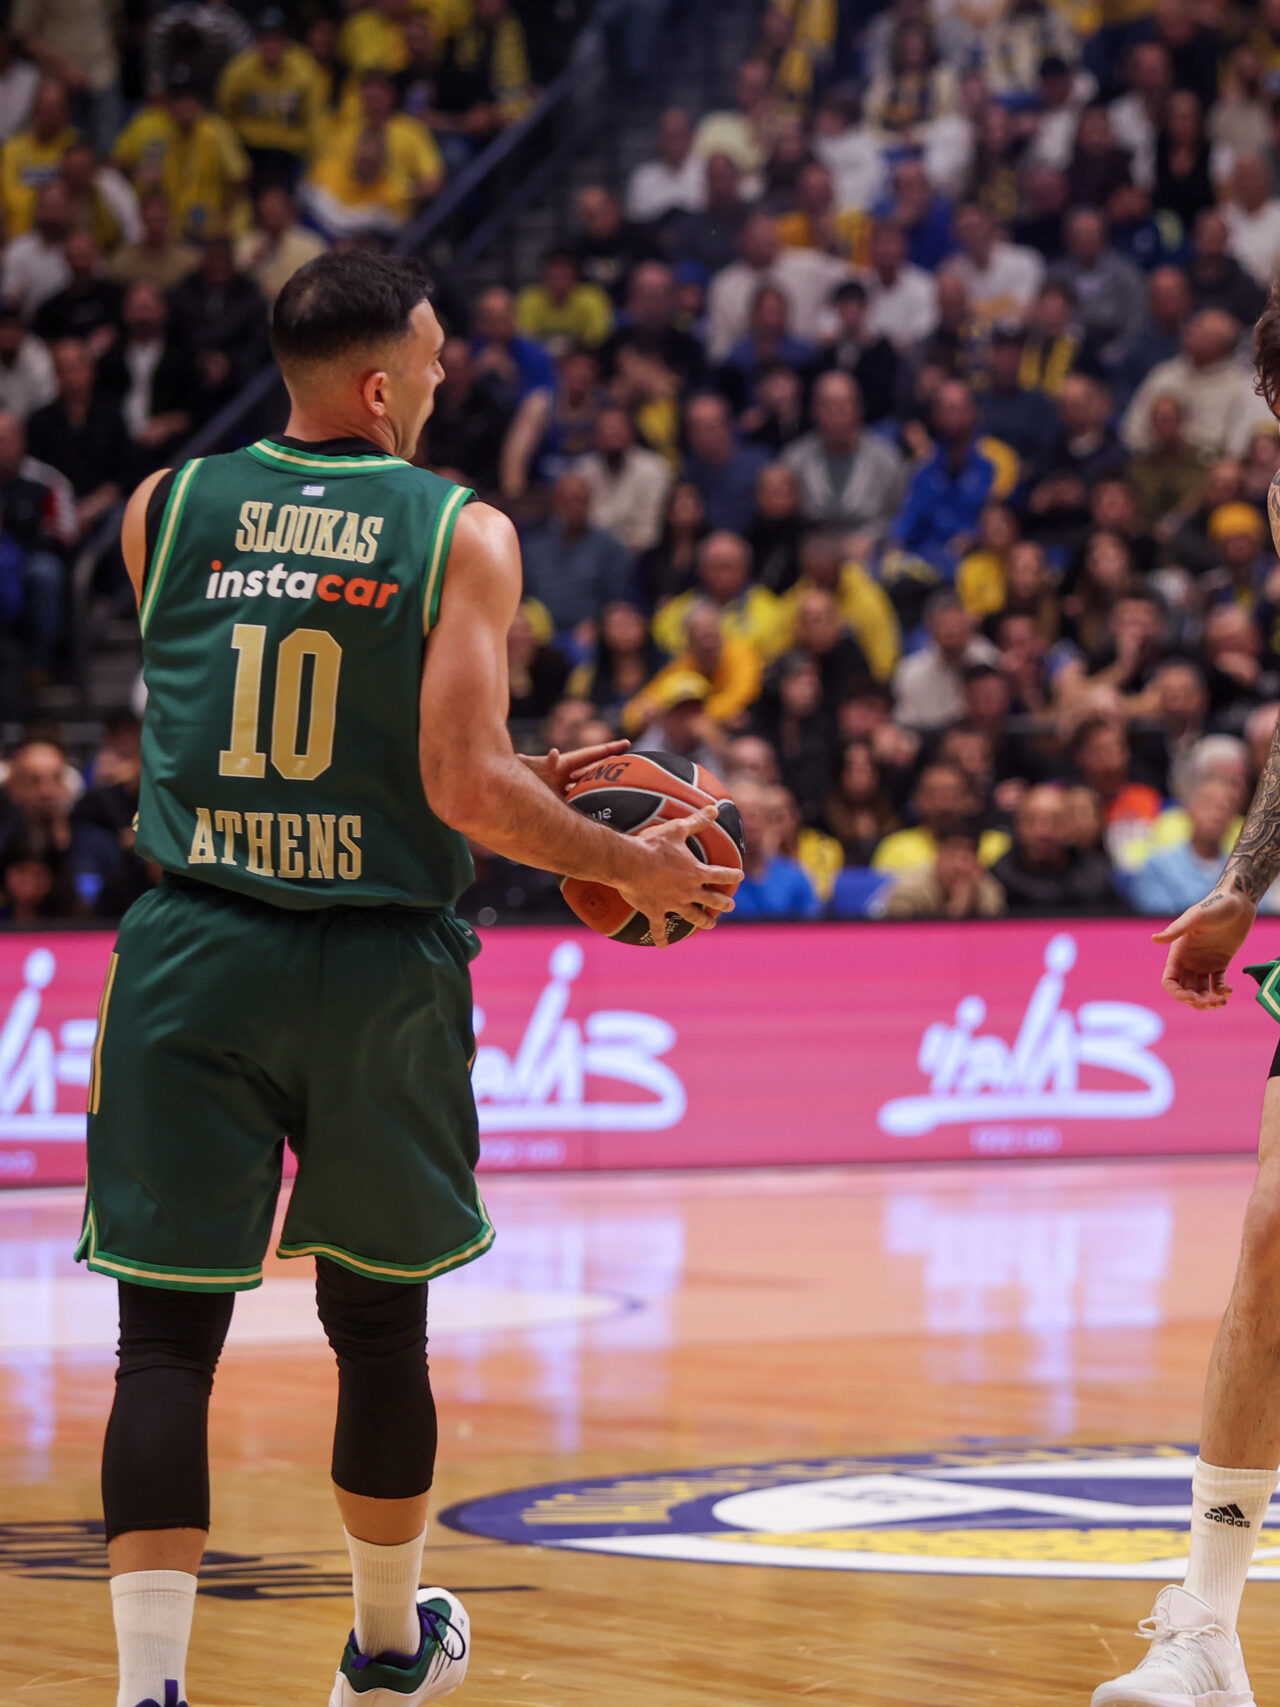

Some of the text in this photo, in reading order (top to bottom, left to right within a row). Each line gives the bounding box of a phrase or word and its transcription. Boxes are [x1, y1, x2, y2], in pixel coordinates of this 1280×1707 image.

[235, 500, 384, 564] SLOUKAS
[206, 559, 399, 609] instacar
[218, 622, 343, 781] 10
[188, 807, 363, 880] ATHENS
[1204, 1511, 1251, 1529] adidas
